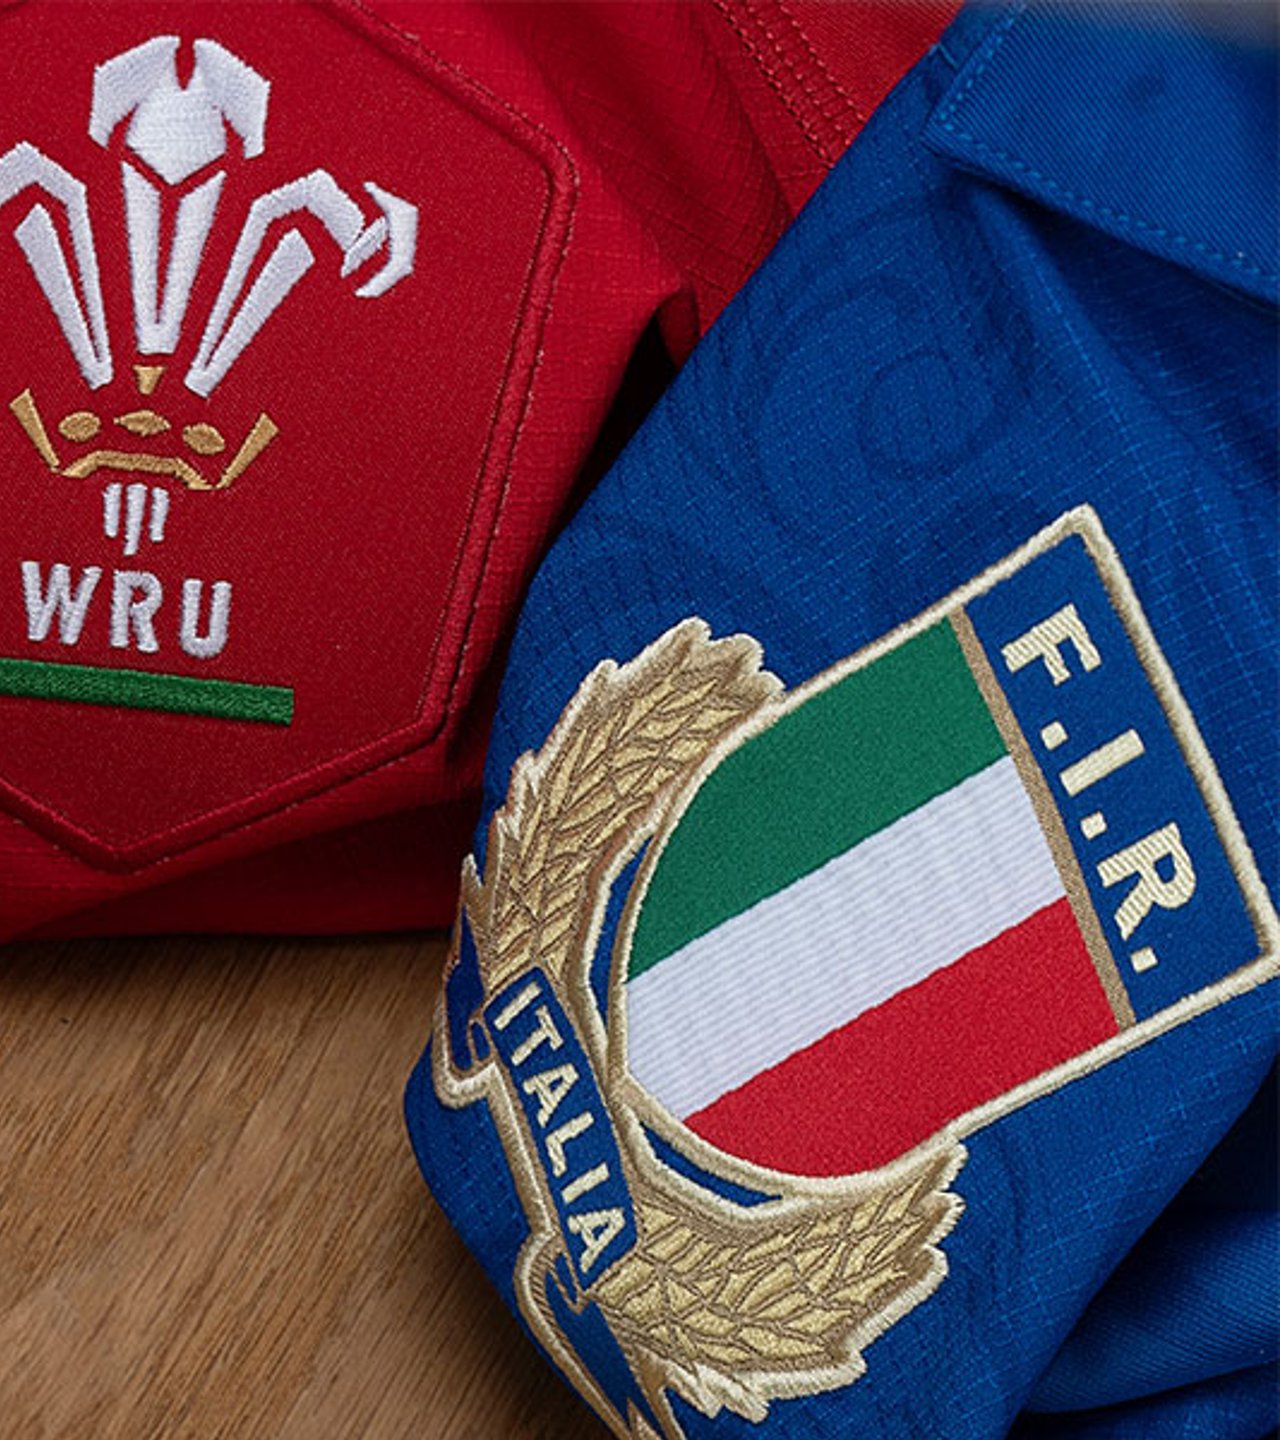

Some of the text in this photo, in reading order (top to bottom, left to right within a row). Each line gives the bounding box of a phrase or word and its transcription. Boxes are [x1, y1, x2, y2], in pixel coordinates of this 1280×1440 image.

[20, 560, 233, 659] WRU
[1000, 602, 1198, 974] F.I.R.
[493, 981, 627, 1275] ITALIA
